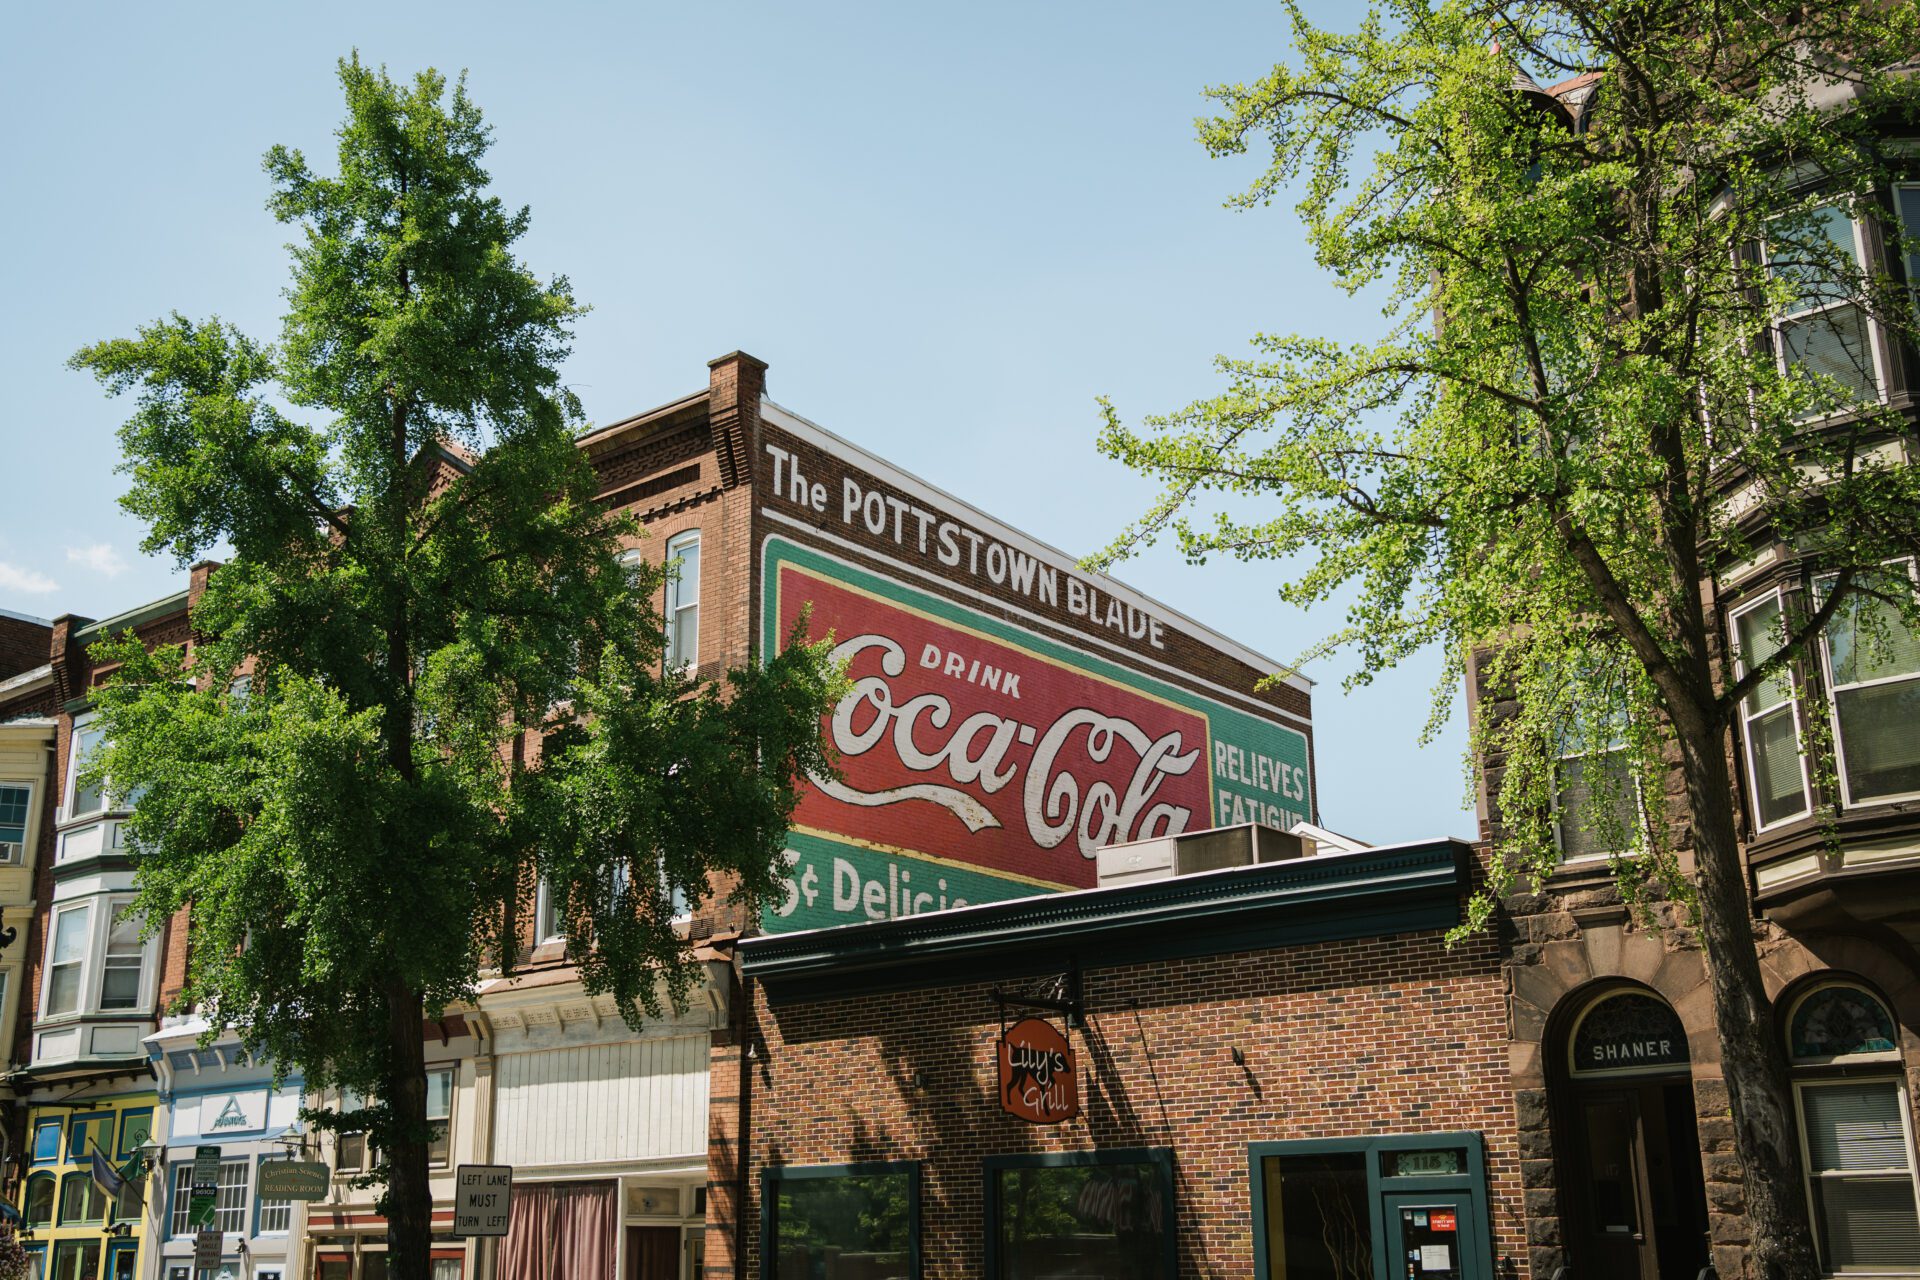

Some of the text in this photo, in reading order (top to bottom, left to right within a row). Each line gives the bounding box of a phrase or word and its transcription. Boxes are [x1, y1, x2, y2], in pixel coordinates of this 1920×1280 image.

[766, 444, 1165, 650] The POTTSTOWN BLADE
[919, 643, 1022, 700] DRINK
[1214, 740, 1304, 802] RELIEVES
[1592, 1040, 1671, 1060] SHANER
[1007, 1040, 1064, 1085] Lily's
[1023, 1081, 1069, 1116] Grill
[1413, 1155, 1441, 1170] 115
[264, 1184, 323, 1193] READING ROOM
[462, 1174, 508, 1186] LEFT LANE
[469, 1194, 498, 1208] MUST
[458, 1215, 507, 1227] TURN LEFT
